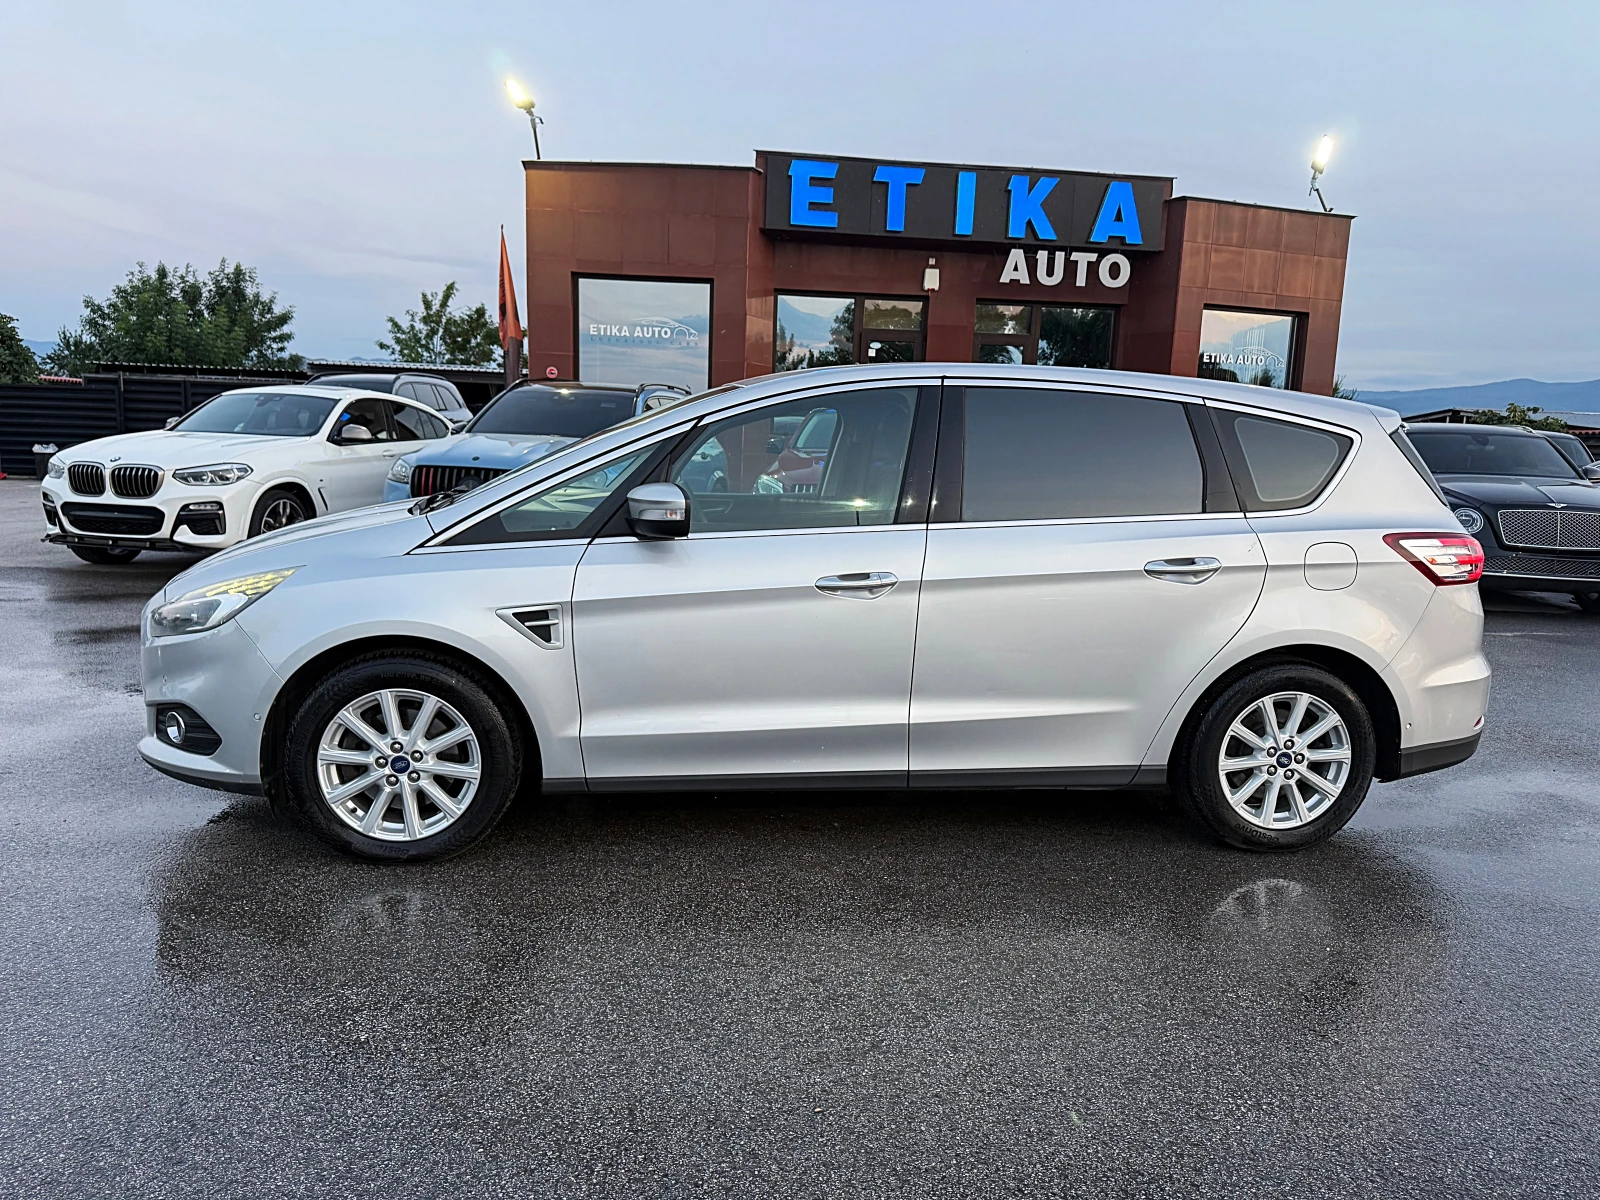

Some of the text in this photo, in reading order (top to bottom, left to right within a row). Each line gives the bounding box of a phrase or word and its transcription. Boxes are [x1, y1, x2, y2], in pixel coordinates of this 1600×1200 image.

[788, 159, 1143, 245] ETIKA
[999, 248, 1131, 288] AUTO
[589, 324, 671, 339] ETIKA AUTO
[1203, 352, 1265, 366] ETIKA AUTO
